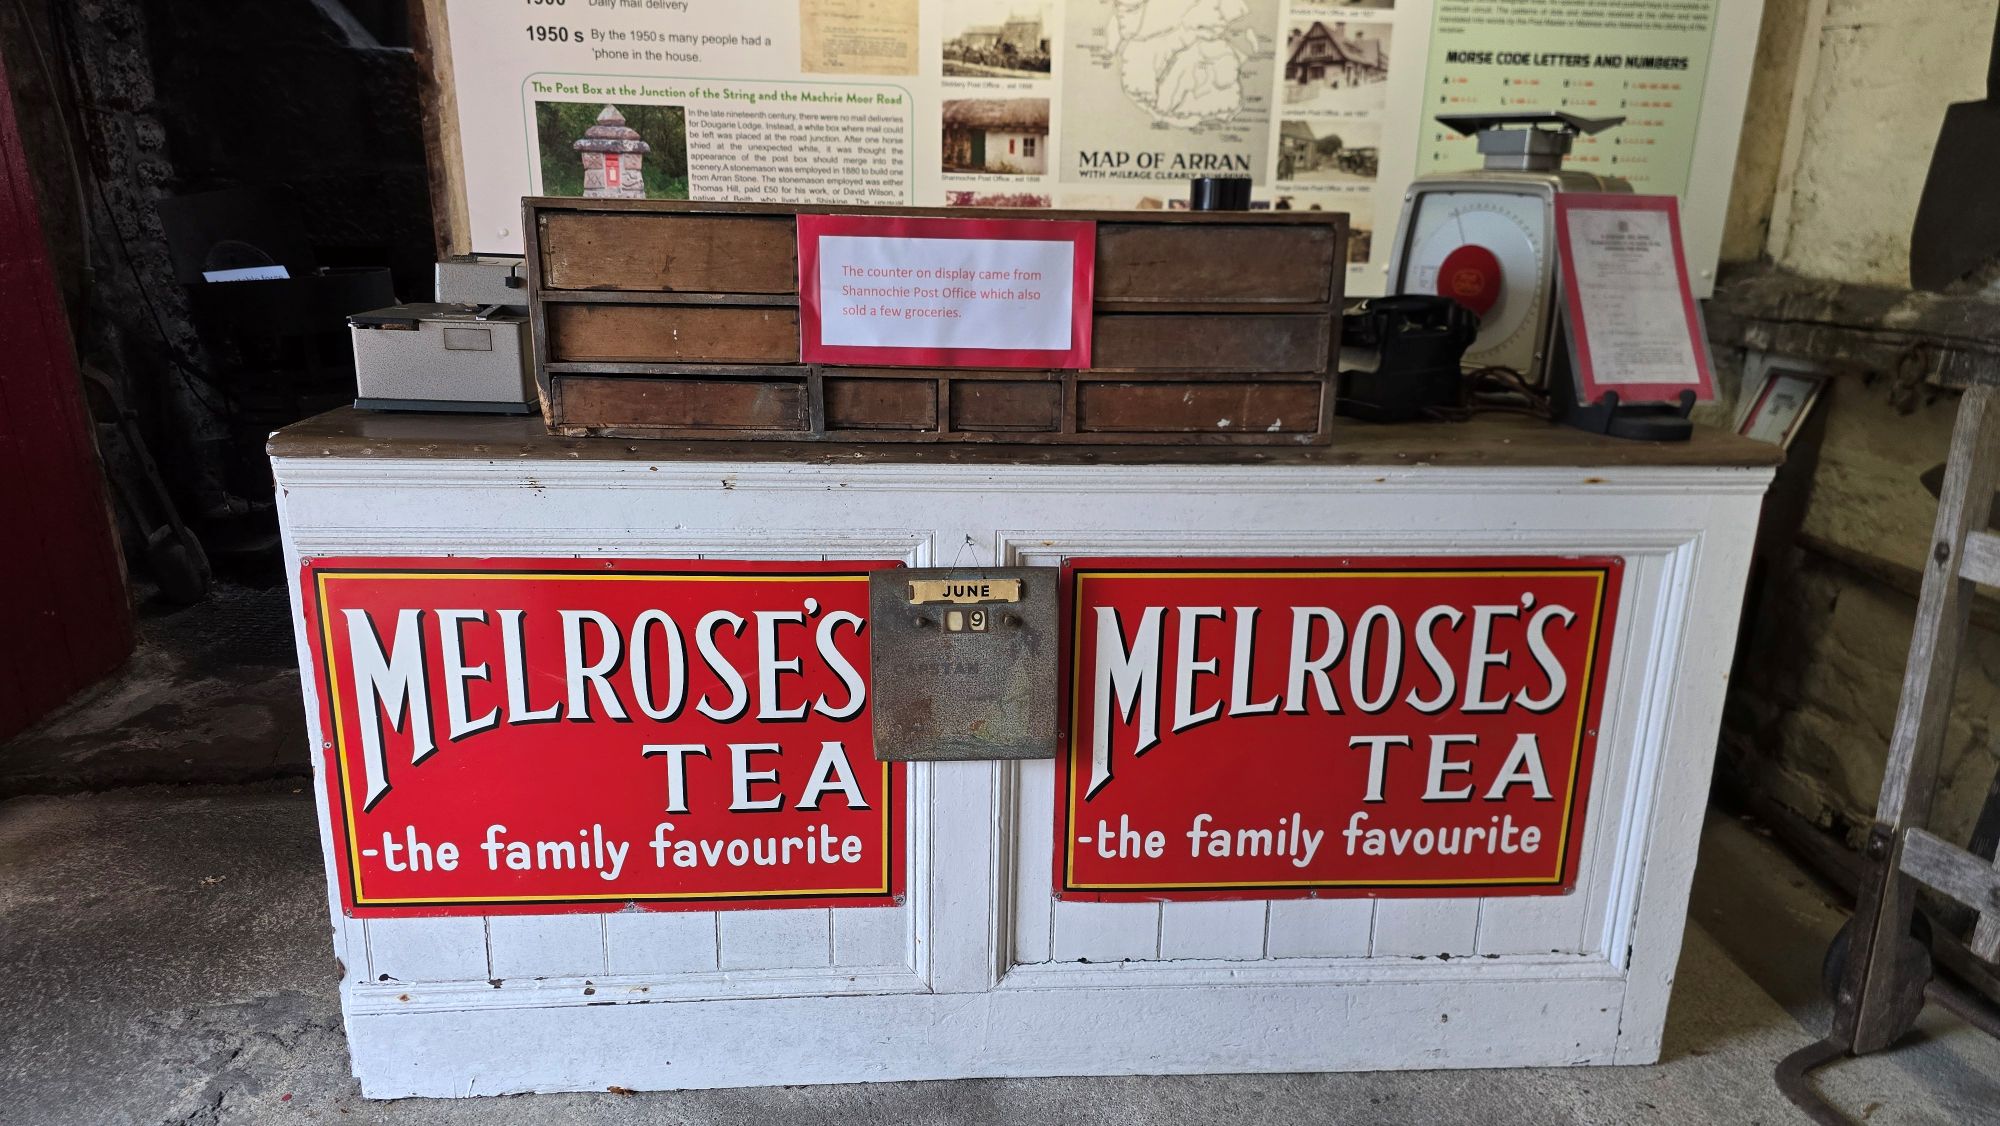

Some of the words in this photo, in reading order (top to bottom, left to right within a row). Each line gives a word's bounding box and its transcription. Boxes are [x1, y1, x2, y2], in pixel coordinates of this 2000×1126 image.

[620, 0, 642, 9] mail
[646, 0, 689, 12] delivery
[526, 25, 569, 42] 1950
[574, 30, 584, 42] s
[591, 29, 605, 44] By
[609, 29, 626, 41] the
[630, 30, 656, 42] 1950
[669, 34, 698, 46] many
[702, 35, 738, 49] people
[742, 35, 762, 46] had
[765, 37, 772, 46] a
[592, 48, 629, 62] 'phone
[632, 49, 643, 60] in
[645, 50, 662, 61] the
[665, 50, 702, 62] house.
[1446, 51, 1494, 65] MORSE
[1496, 52, 1531, 66] CODE
[1534, 53, 1590, 68] LETTERS
[1593, 54, 1623, 69] AND
[1625, 55, 1689, 71] NUMBERS
[532, 82, 552, 93] The
[555, 82, 579, 94] Post
[583, 83, 602, 95] Box
[606, 85, 616, 95] at
[619, 84, 637, 96] the
[639, 86, 686, 98] Junction
[689, 87, 700, 98] of
[702, 87, 720, 99] the
[723, 88, 756, 104] String
[758, 90, 778, 101] and
[780, 91, 798, 102] the
[801, 91, 843, 103] Machrie
[846, 93, 873, 104] Moor
[876, 94, 903, 105] Road
[688, 109, 696, 117] In
[697, 109, 709, 117] the
[711, 110, 725, 118] late
[726, 110, 766, 119] nineteenth
[868, 115, 903, 123] deliveries
[826, 124, 839, 132] box
[866, 125, 881, 133] mail
[883, 126, 904, 134] could
[702, 131, 714, 139] left
[735, 132, 761, 141] placed
[844, 135, 862, 143] After
[882, 136, 903, 144] horse
[689, 142, 711, 150] shied
[717, 142, 724, 150] at
[748, 143, 793, 152] unexpected
[826, 145, 831, 153] it
[857, 146, 886, 156] thought
[891, 147, 904, 155] the
[690, 154, 736, 162] appearance
[772, 155, 788, 163] post
[813, 156, 838, 164] should
[843, 157, 867, 166] merge
[873, 157, 887, 165] into
[891, 157, 903, 165] the
[1079, 151, 1130, 168] MAP
[1137, 152, 1165, 169] OF
[1170, 153, 1250, 171] ARRAN
[730, 164, 777, 173] stonemason
[794, 166, 832, 175] employed
[861, 167, 869, 175] to
[870, 167, 889, 175] build
[1079, 170, 1106, 179] WITH
[1109, 171, 1152, 180] MILEAGE
[1154, 171, 1197, 180] CLEARLY
[691, 173, 709, 181] from
[778, 176, 824, 184] stonemason
[826, 178, 864, 187] employed
[692, 183, 724, 192] Thomas
[744, 185, 761, 194] paid
[763, 185, 779, 193] £50
[843, 187, 865, 195] David
[842, 265, 864, 278] The
[867, 267, 912, 279] counter
[916, 269, 931, 279] on
[935, 267, 976, 283] display
[978, 270, 1010, 281] came
[1013, 268, 1042, 281] from
[842, 285, 910, 298] Shannochie
[913, 287, 939, 299] Post
[942, 287, 976, 300] Office
[980, 288, 1015, 300] which
[1018, 289, 1041, 301] also
[842, 304, 867, 316] sold
[870, 308, 877, 317] a
[880, 305, 901, 317] few
[904, 307, 962, 320] groceries.
[942, 585, 990, 597] JUNE
[971, 610, 984, 627] 9
[341, 597, 867, 812] MELROSE'S
[1084, 592, 1577, 802] MELROSE'S
[1348, 733, 1555, 801] TEA
[641, 740, 872, 813] TEA
[1186, 812, 1325, 868] family
[1342, 811, 1540, 857] favourite
[480, 824, 630, 881] family
[649, 822, 862, 869] favourite
